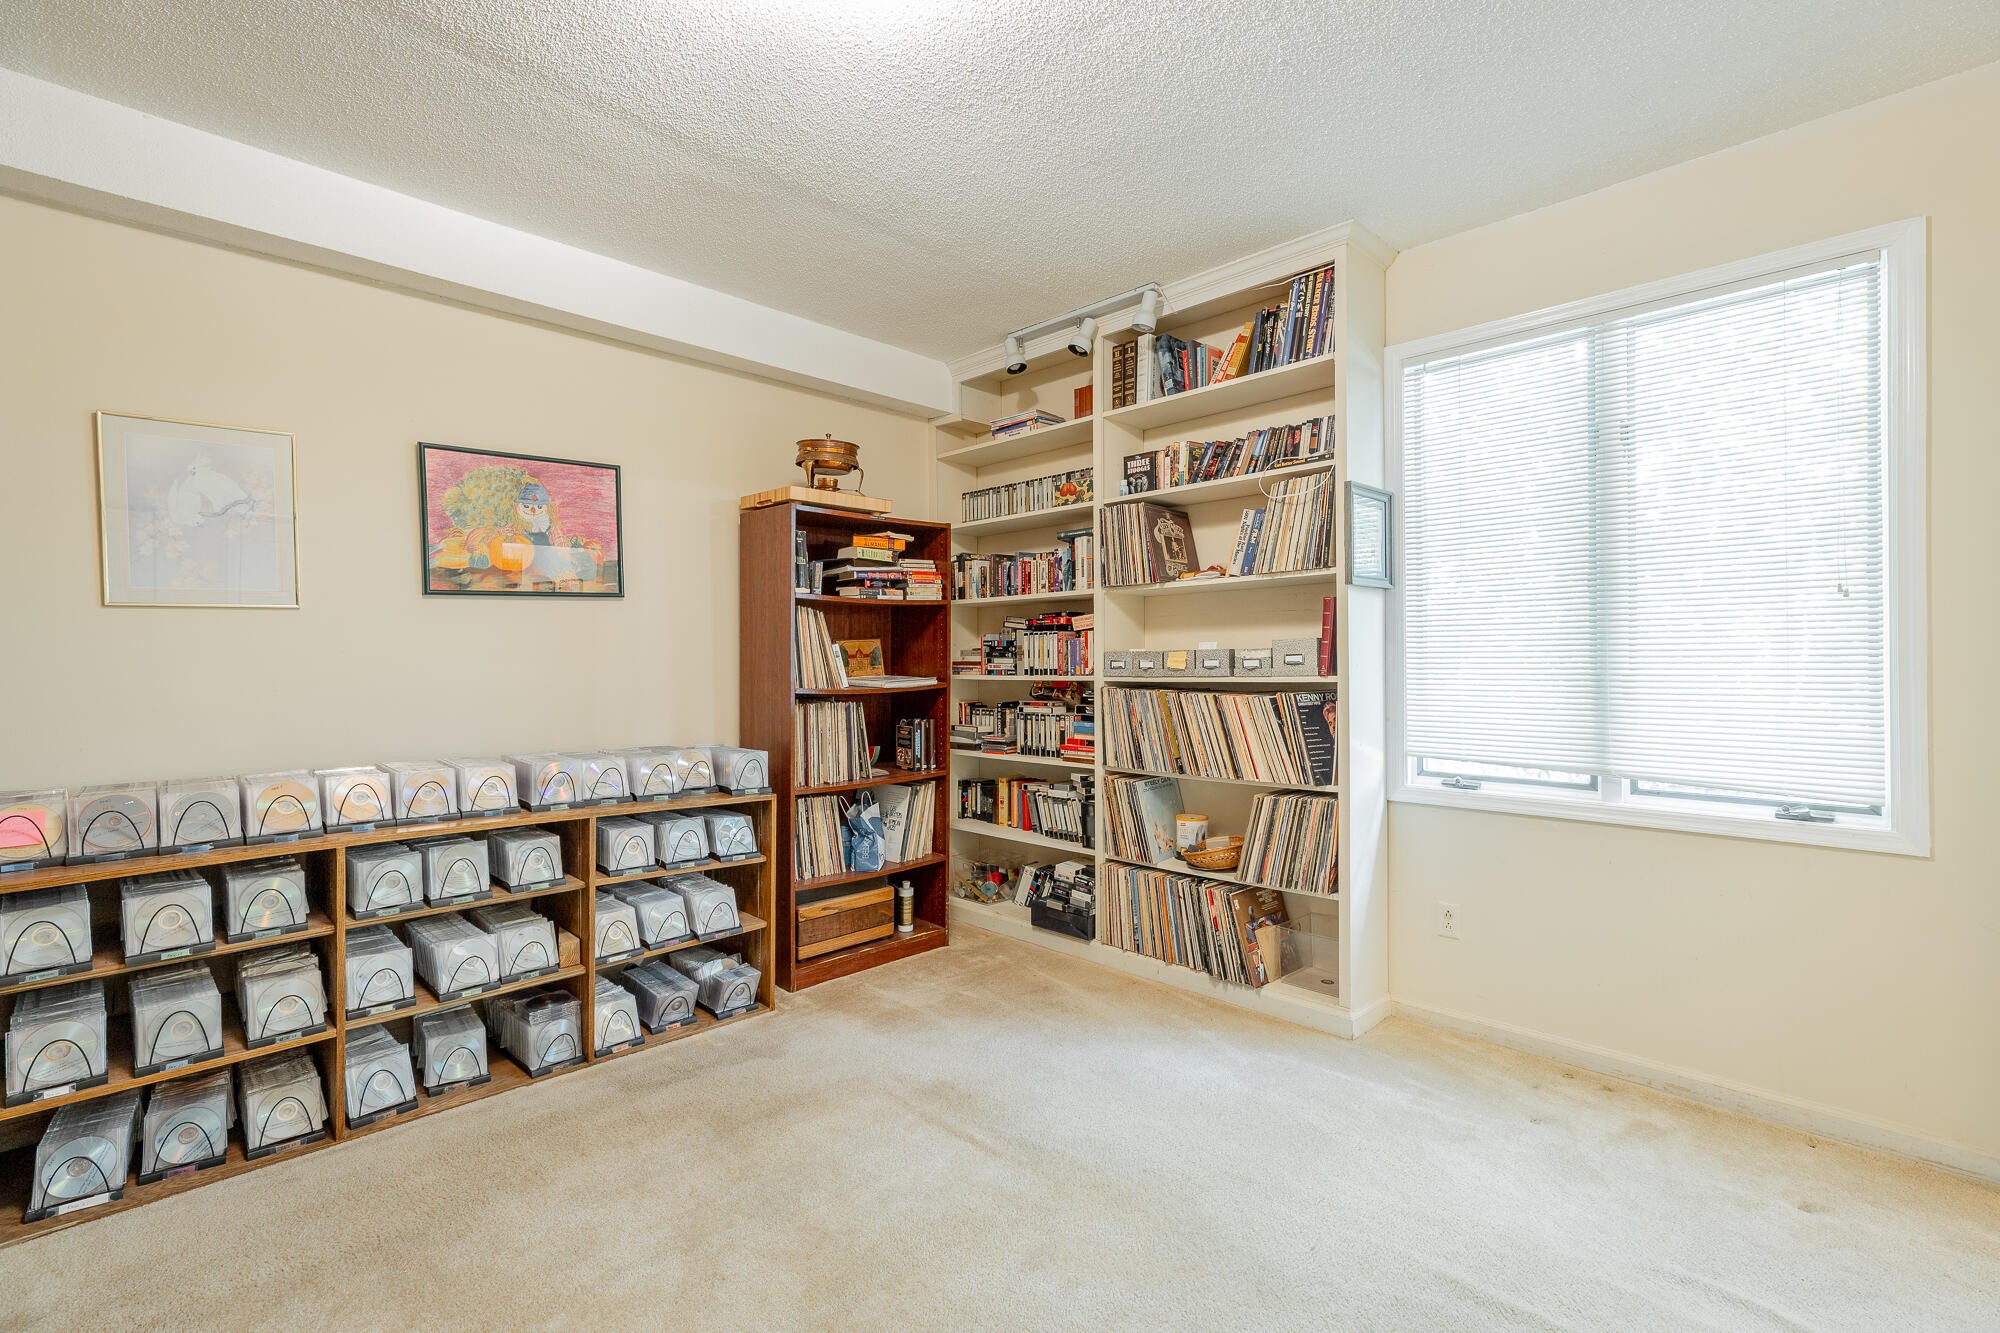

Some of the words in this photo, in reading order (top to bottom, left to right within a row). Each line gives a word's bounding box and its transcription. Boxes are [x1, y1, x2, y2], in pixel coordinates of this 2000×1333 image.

[1306, 328, 1316, 354] STORY
[1127, 458, 1150, 468] THREE
[1127, 464, 1150, 474] STOOGES
[1296, 693, 1324, 702] KENNY
